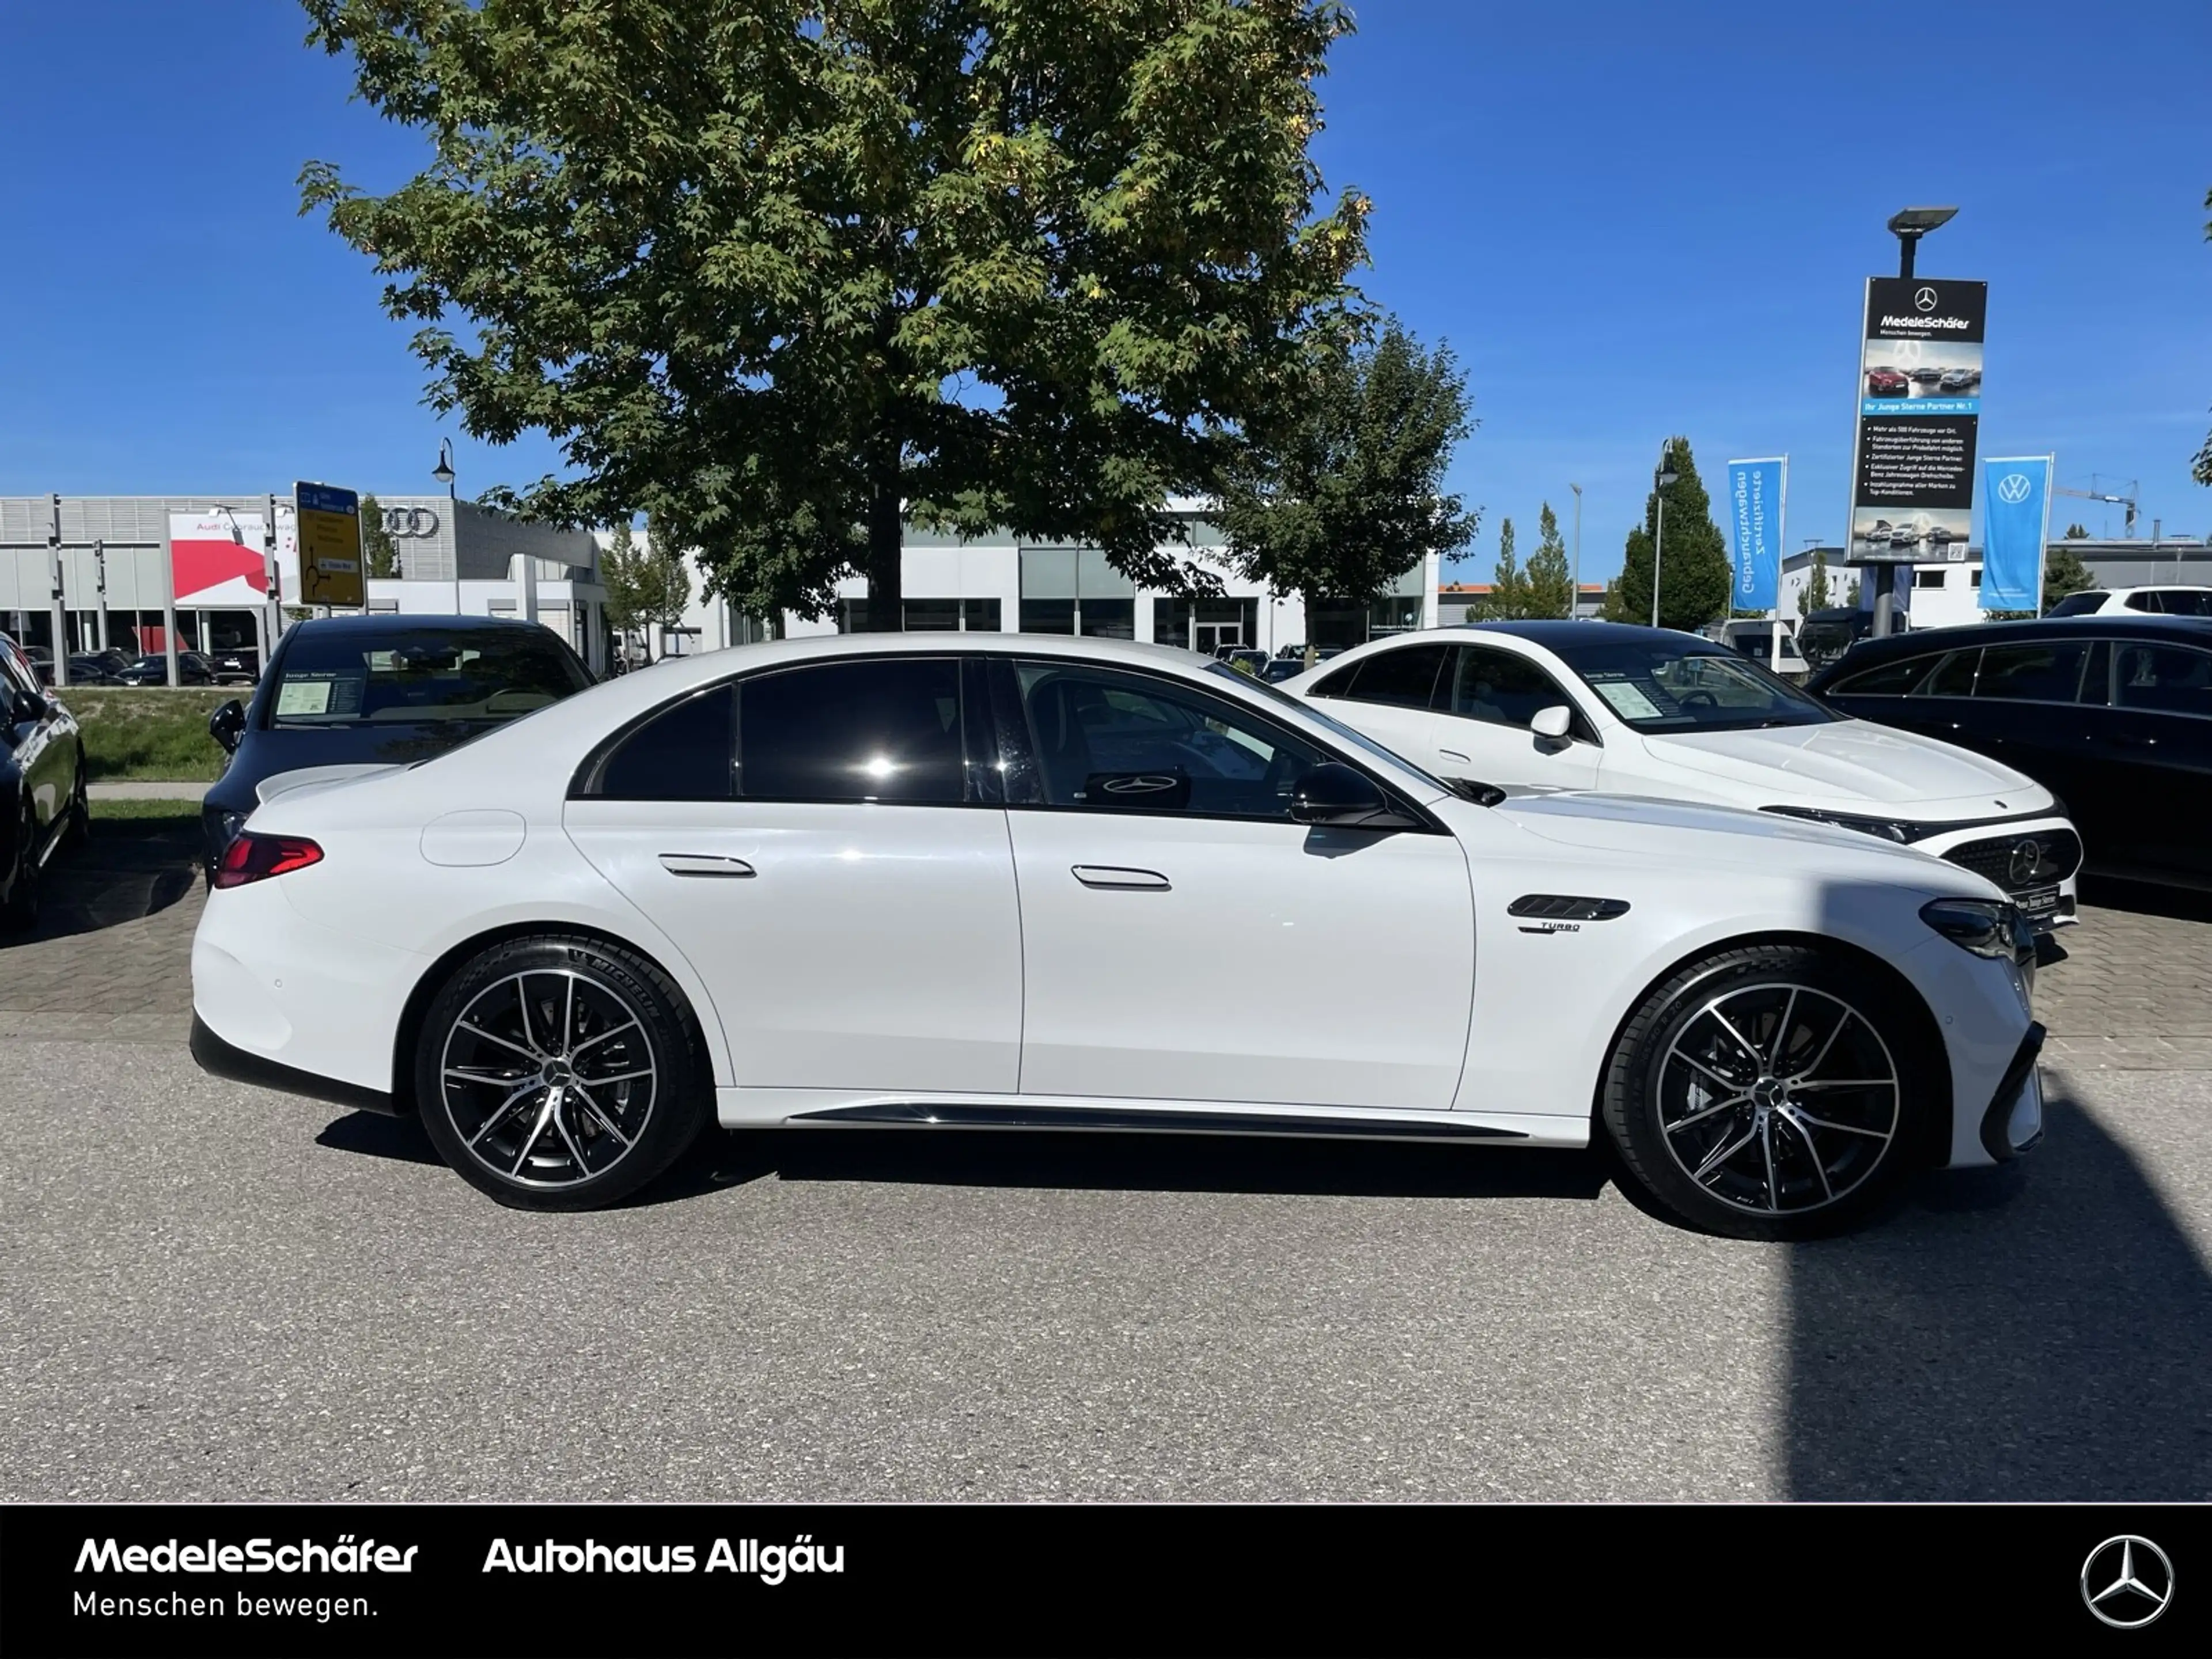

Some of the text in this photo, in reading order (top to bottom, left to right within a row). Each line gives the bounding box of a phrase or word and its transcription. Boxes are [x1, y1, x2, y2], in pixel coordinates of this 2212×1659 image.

[1880, 315, 1969, 329] MedeleSchäfer
[1878, 403, 1899, 412] Junge
[1901, 403, 1925, 411] Sterne
[1927, 403, 1955, 411] Partner
[1541, 922, 1581, 932] TURBO
[591, 959, 661, 1018] MICHELIN
